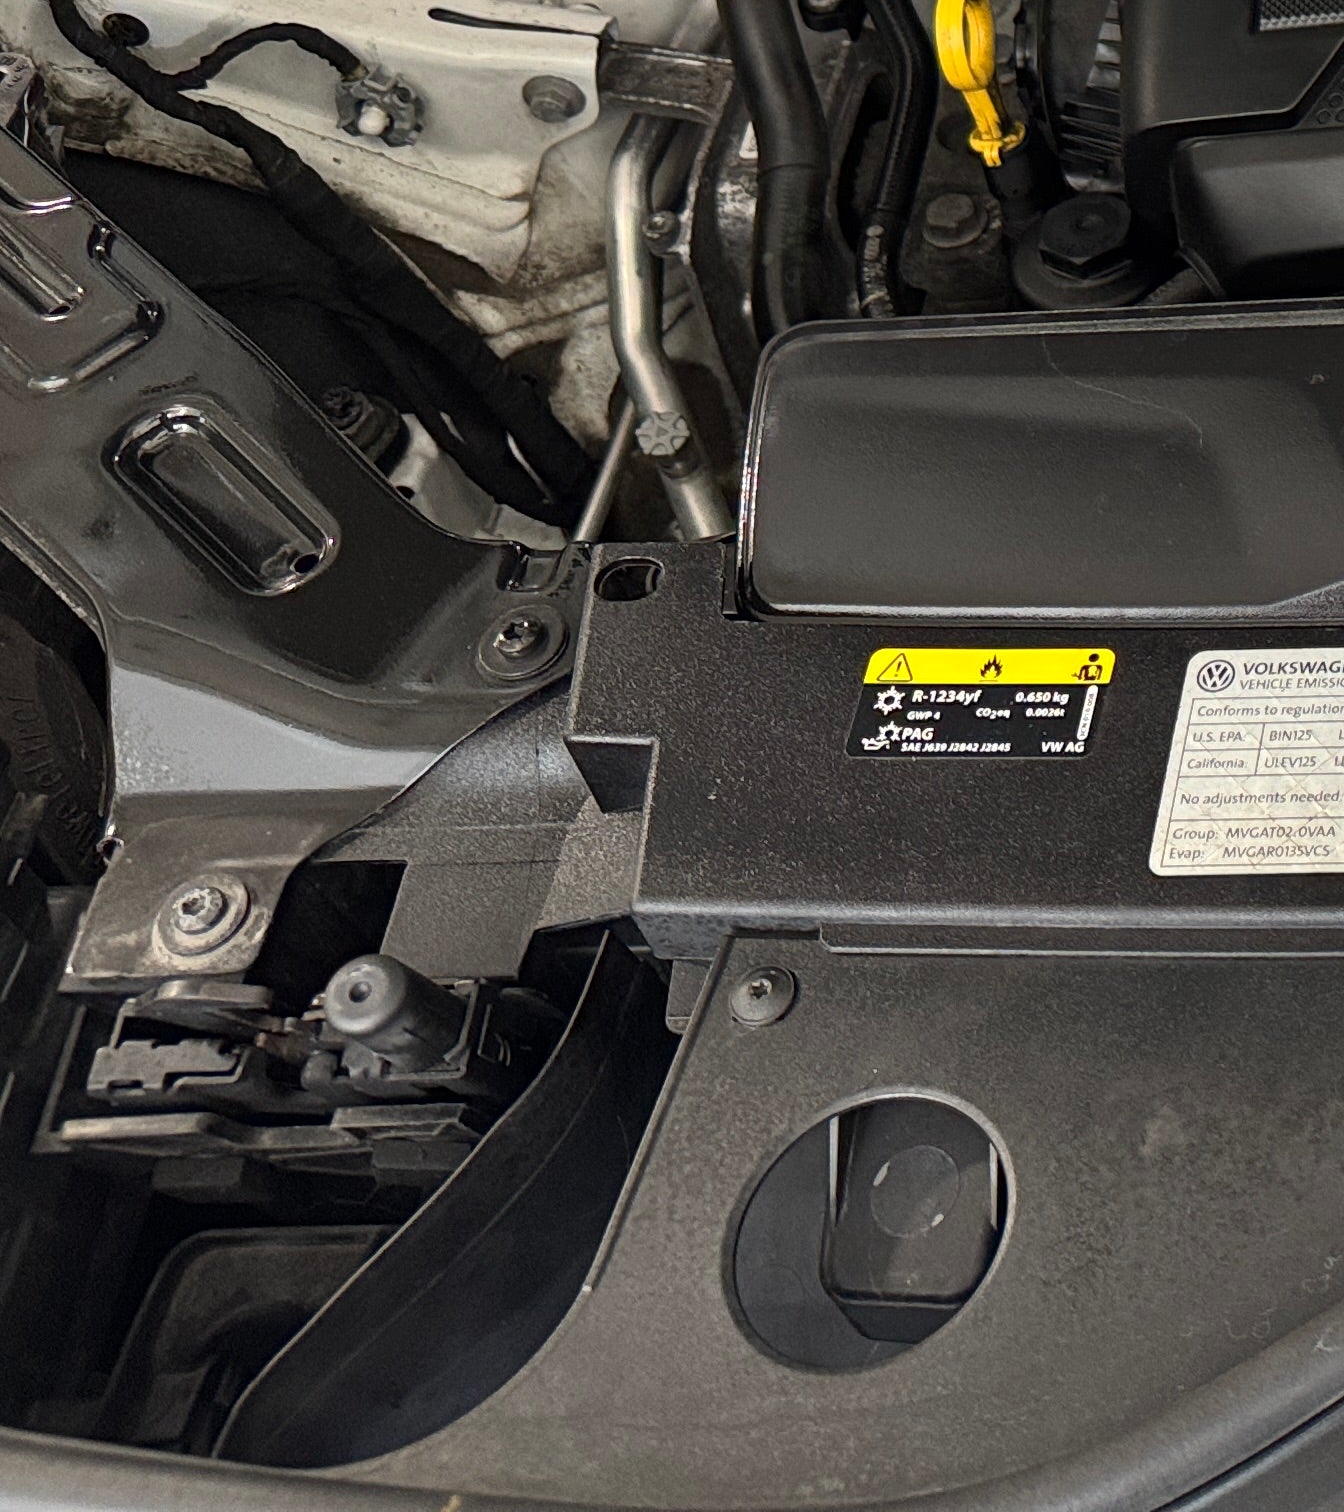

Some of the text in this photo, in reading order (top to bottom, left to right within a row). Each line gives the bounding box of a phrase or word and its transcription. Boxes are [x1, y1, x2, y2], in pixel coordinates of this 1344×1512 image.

[1240, 678, 1292, 690] VEHICLE
[911, 690, 1070, 706] R-1234yf 0.650 kg
[907, 710, 941, 721] GWP 4
[1197, 705, 1260, 718] Conforms
[1264, 705, 1278, 716] to
[902, 727, 934, 741] PAG
[1193, 731, 1216, 742] U.S.
[1270, 729, 1313, 741] BIN125
[901, 742, 1011, 753] SAE J639 J2842 J2845
[1041, 741, 1085, 753] VW AG
[1180, 793, 1200, 805] No
[1203, 791, 1286, 808] adjustments
[1172, 827, 1219, 843] Group:
[1169, 847, 1204, 862] Evap:
